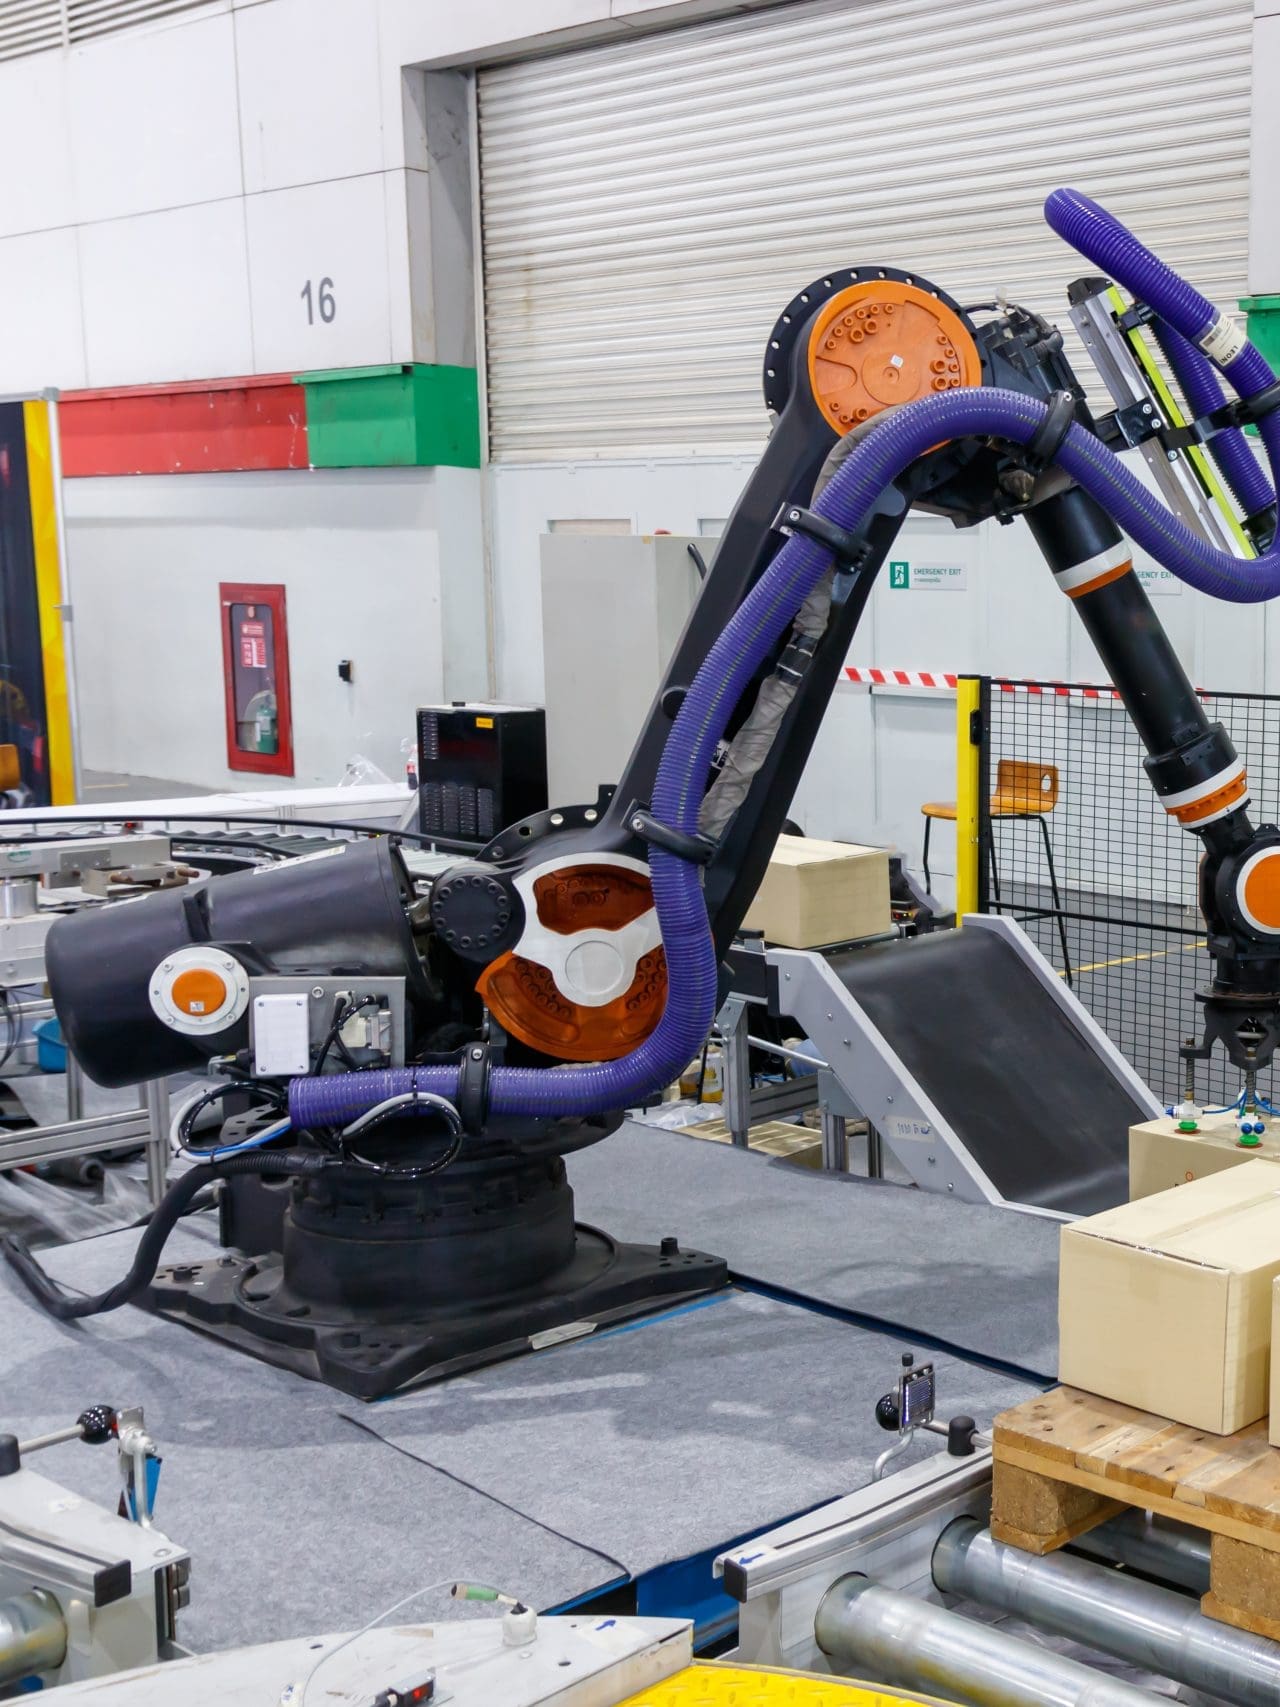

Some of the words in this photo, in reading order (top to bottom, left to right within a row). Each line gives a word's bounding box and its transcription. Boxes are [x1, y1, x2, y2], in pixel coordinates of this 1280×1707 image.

[301, 277, 336, 325] 16
[1219, 345, 1239, 364] LEONI
[914, 568, 947, 576] EMERGENCY
[949, 568, 962, 576] EXIT
[1136, 571, 1158, 579] GENCY
